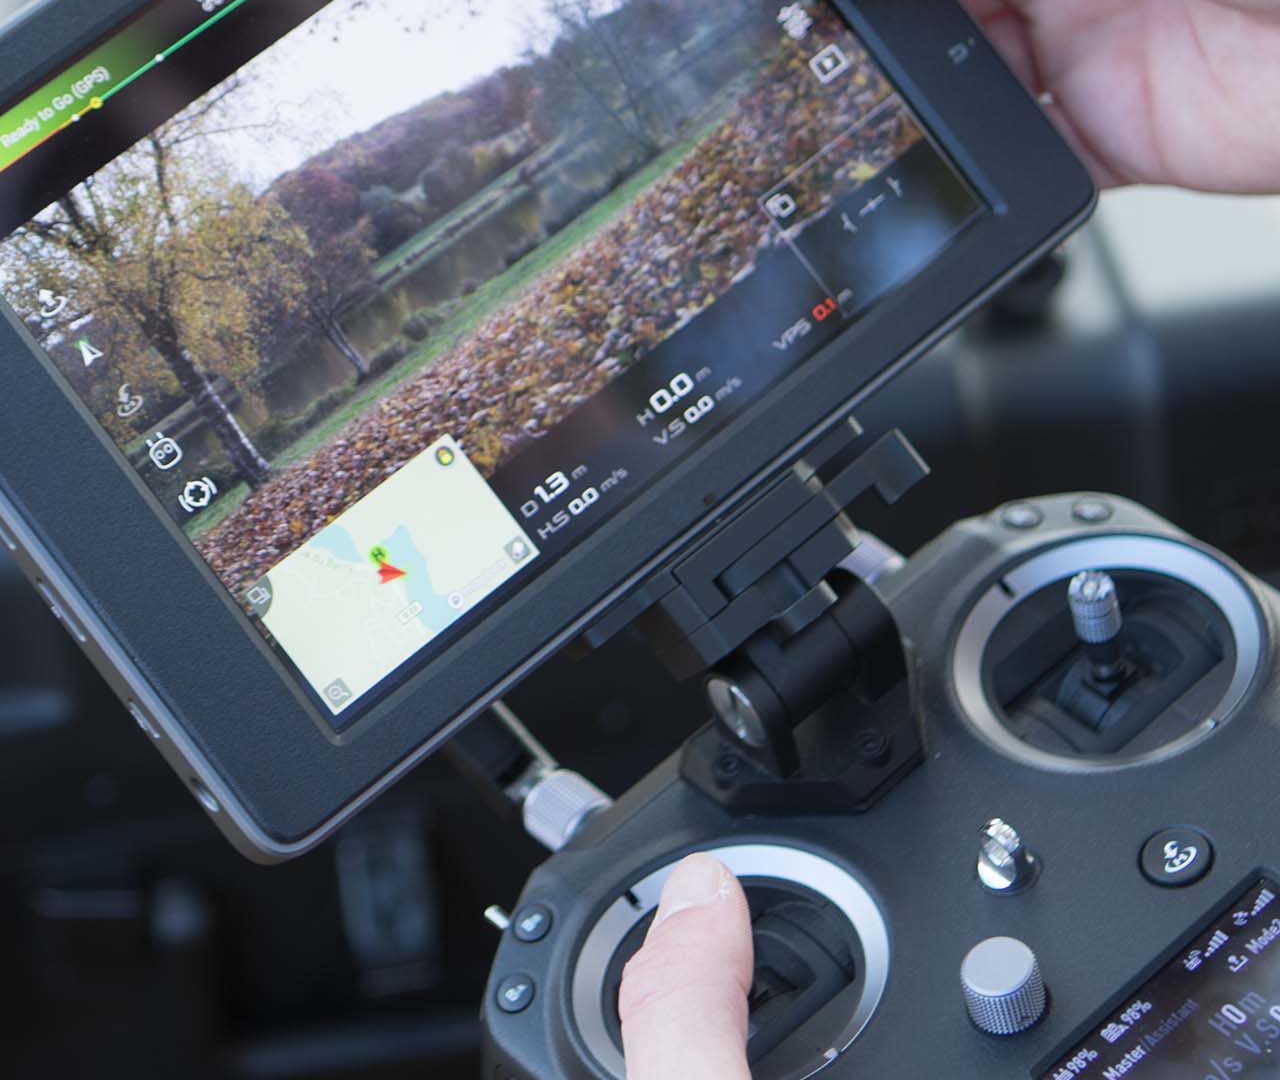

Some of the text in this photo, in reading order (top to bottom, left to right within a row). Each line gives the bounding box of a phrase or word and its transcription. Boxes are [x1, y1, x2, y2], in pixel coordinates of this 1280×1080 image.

[0, 65, 111, 149] Ready to Go (GPS)
[771, 317, 812, 350] VPS
[810, 296, 837, 322] 0.1
[636, 407, 656, 428] H
[648, 372, 695, 414] 0.0
[683, 395, 715, 425] 0.0
[520, 464, 588, 519] D 1.3 m
[567, 487, 600, 516] 0.0
[600, 467, 629, 493] m/s
[1120, 999, 1153, 1025] 98%
[1065, 1047, 1099, 1074] 98%
